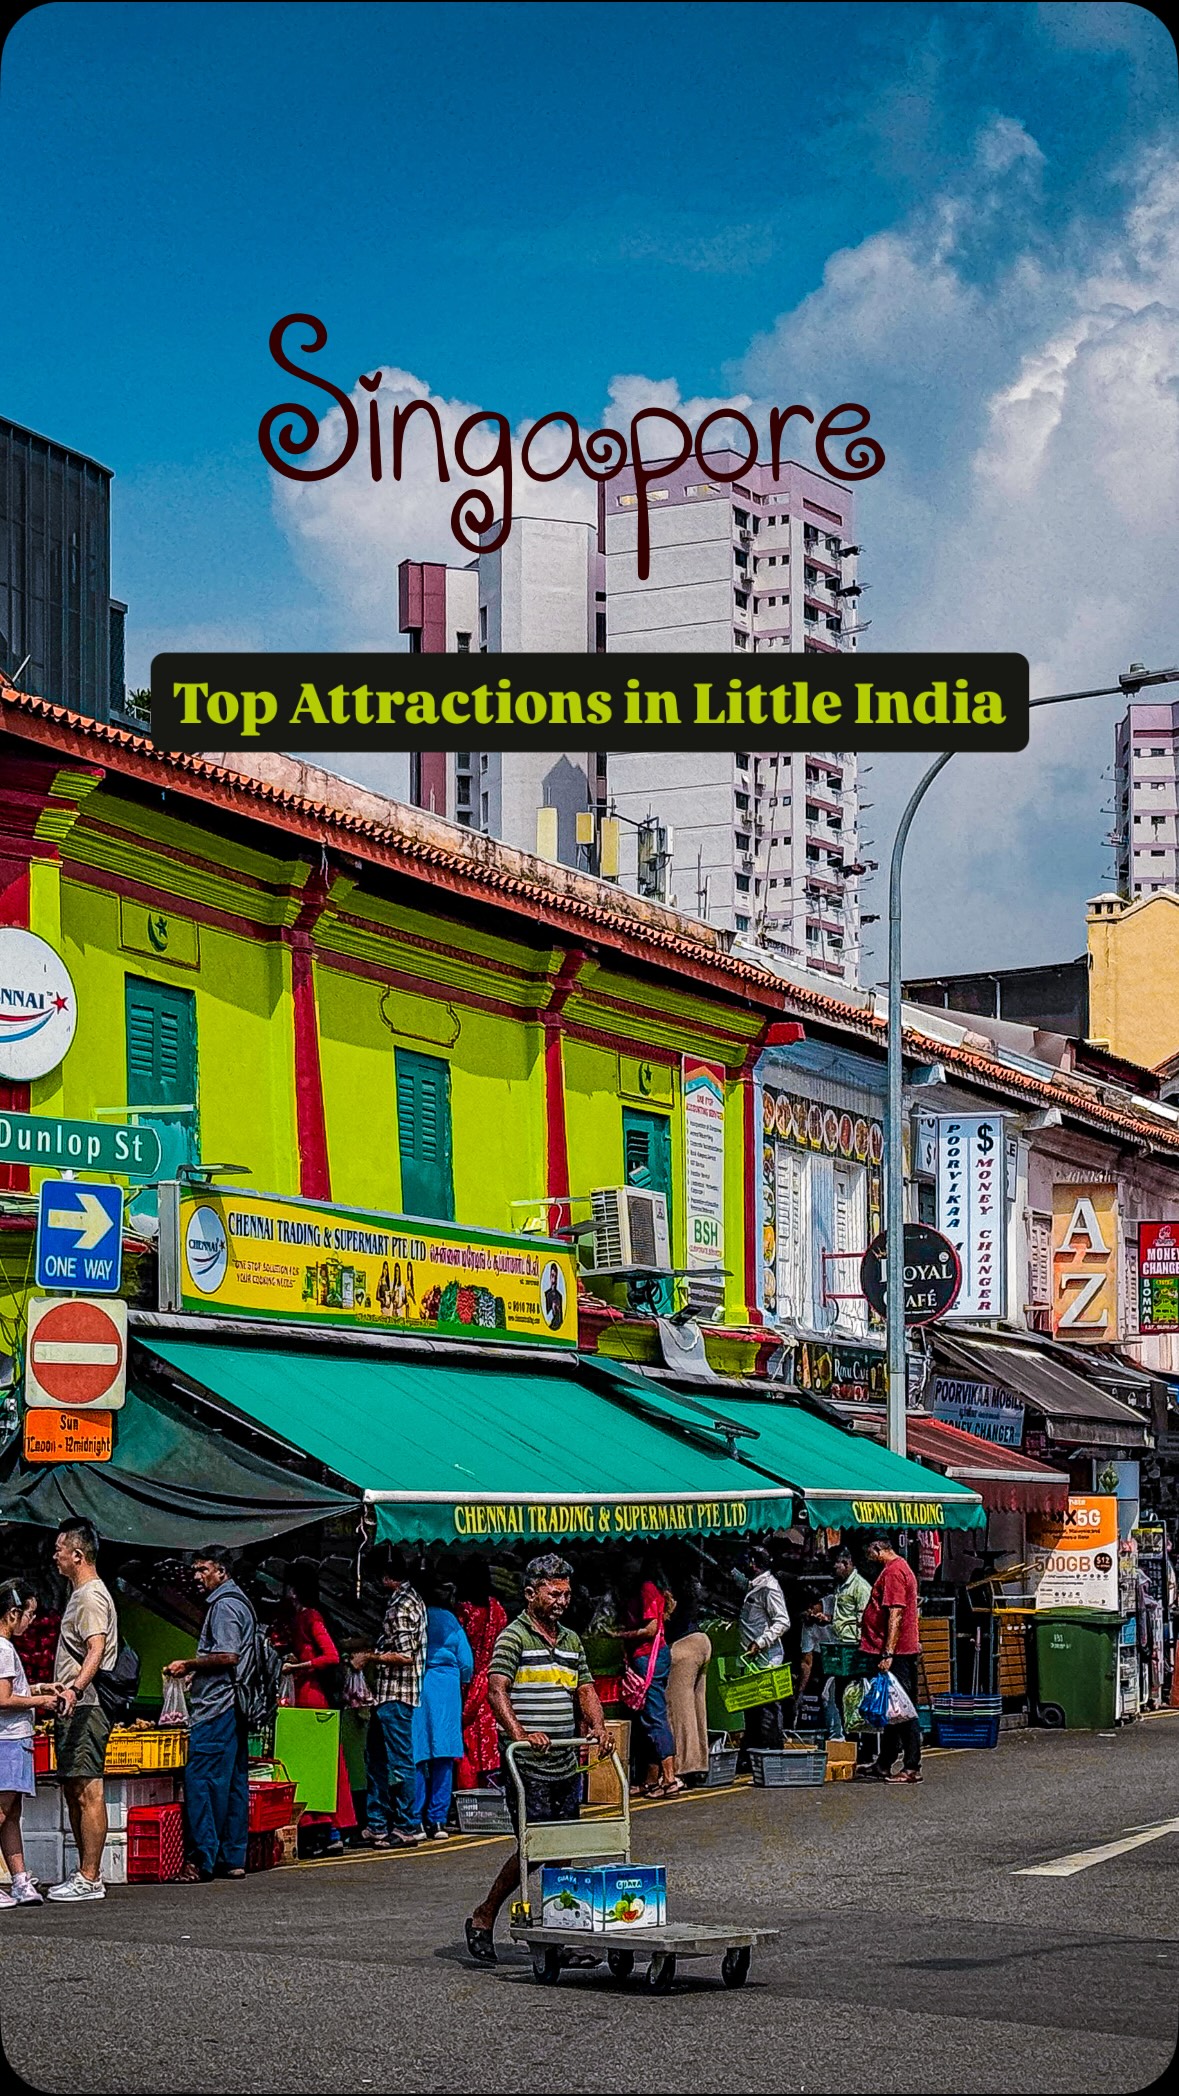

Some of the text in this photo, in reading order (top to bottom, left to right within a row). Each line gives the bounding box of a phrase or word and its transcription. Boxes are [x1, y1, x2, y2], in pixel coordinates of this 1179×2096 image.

[0, 987, 44, 1009] NNAI
[0, 1119, 143, 1164] Dunlop St
[946, 1124, 962, 1228] POORVIKAA
[228, 1212, 426, 1262] CHENNAI TRADING & SUPERMART PTE LTD
[694, 1219, 718, 1247] BSH
[45, 1255, 113, 1280] ONE WAY
[883, 1289, 937, 1308] AFÉ
[1142, 1279, 1152, 1324] BOMMA
[935, 1381, 989, 1407] POORVIKAA
[60, 1414, 79, 1430] Sun
[941, 1419, 1014, 1443] NEY CHANGER
[454, 1502, 747, 1534] CHENNAI TRADING & SUPERMART PTE LTD
[852, 1501, 944, 1525] CHENNAI TRADING
[1035, 1556, 1091, 1572] 500GB
